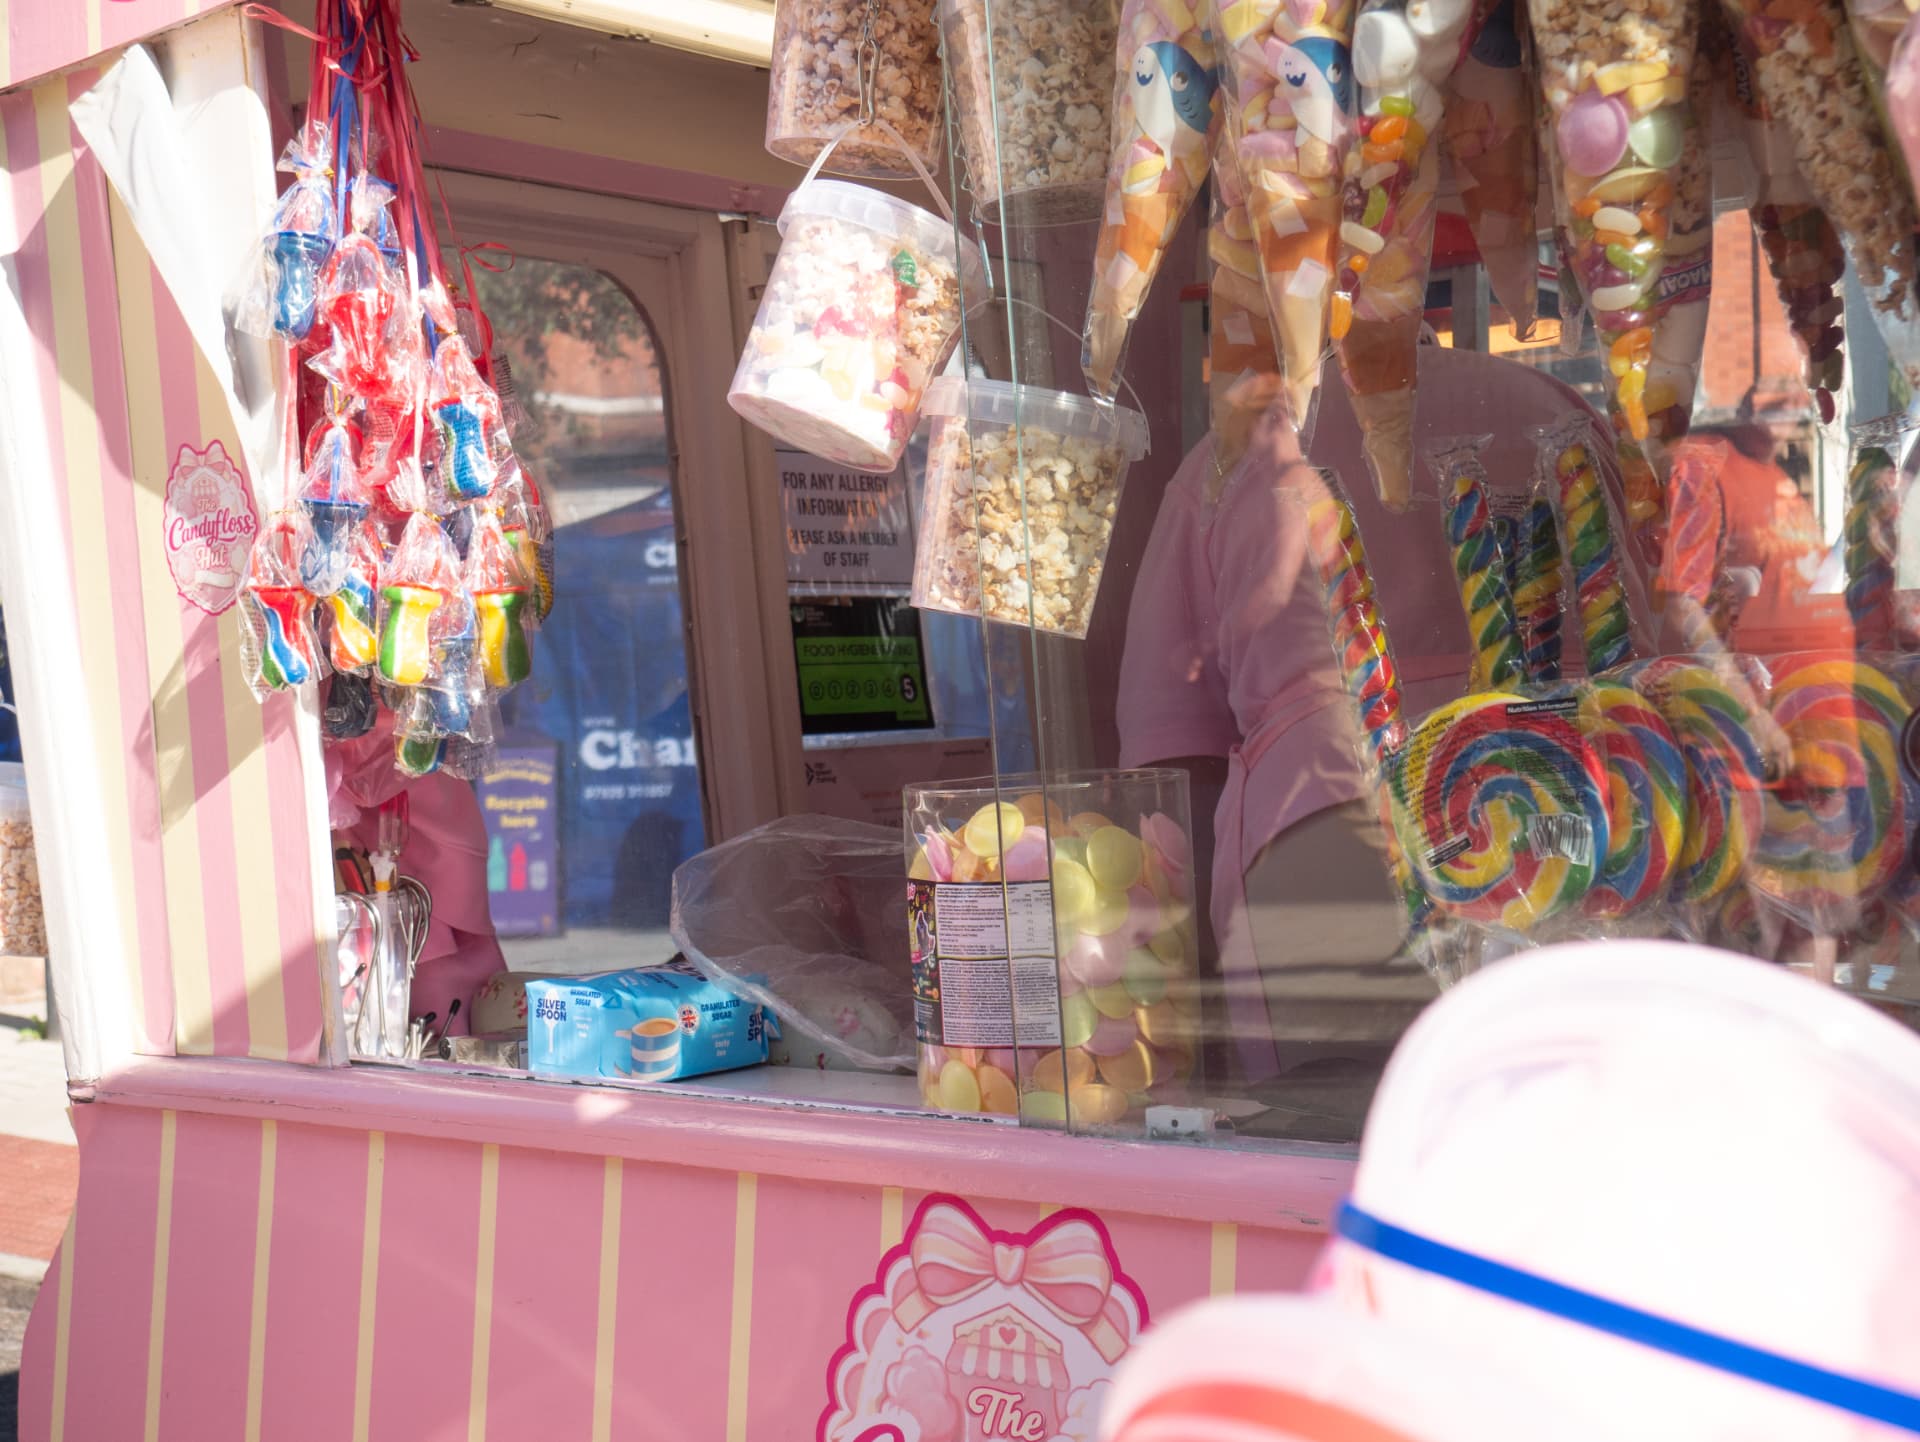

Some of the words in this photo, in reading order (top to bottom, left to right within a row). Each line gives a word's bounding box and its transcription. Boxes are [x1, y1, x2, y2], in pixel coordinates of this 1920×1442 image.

[782, 472, 807, 489] FOR
[810, 472, 834, 491] ANY
[839, 474, 889, 493] ALLERGY
[199, 499, 217, 512] The
[169, 507, 254, 551] Candyfloss
[828, 530, 848, 545] ASK
[850, 531, 857, 545] A
[197, 547, 227, 568] Hut
[823, 552, 837, 567] OF
[840, 552, 870, 567] STAFF
[804, 645, 835, 657] FOOD
[903, 677, 915, 699] 5
[1507, 706, 1537, 714] Nutrition
[1538, 701, 1577, 710] Information
[570, 989, 601, 999] GRANULATED
[537, 998, 566, 1011] SILVER
[575, 998, 591, 1006] SUGAR
[701, 1000, 740, 1013] GRANULATED
[536, 1008, 567, 1022] SPOON
[712, 1011, 733, 1022] SUGAR
[968, 1386, 1045, 1441] The
